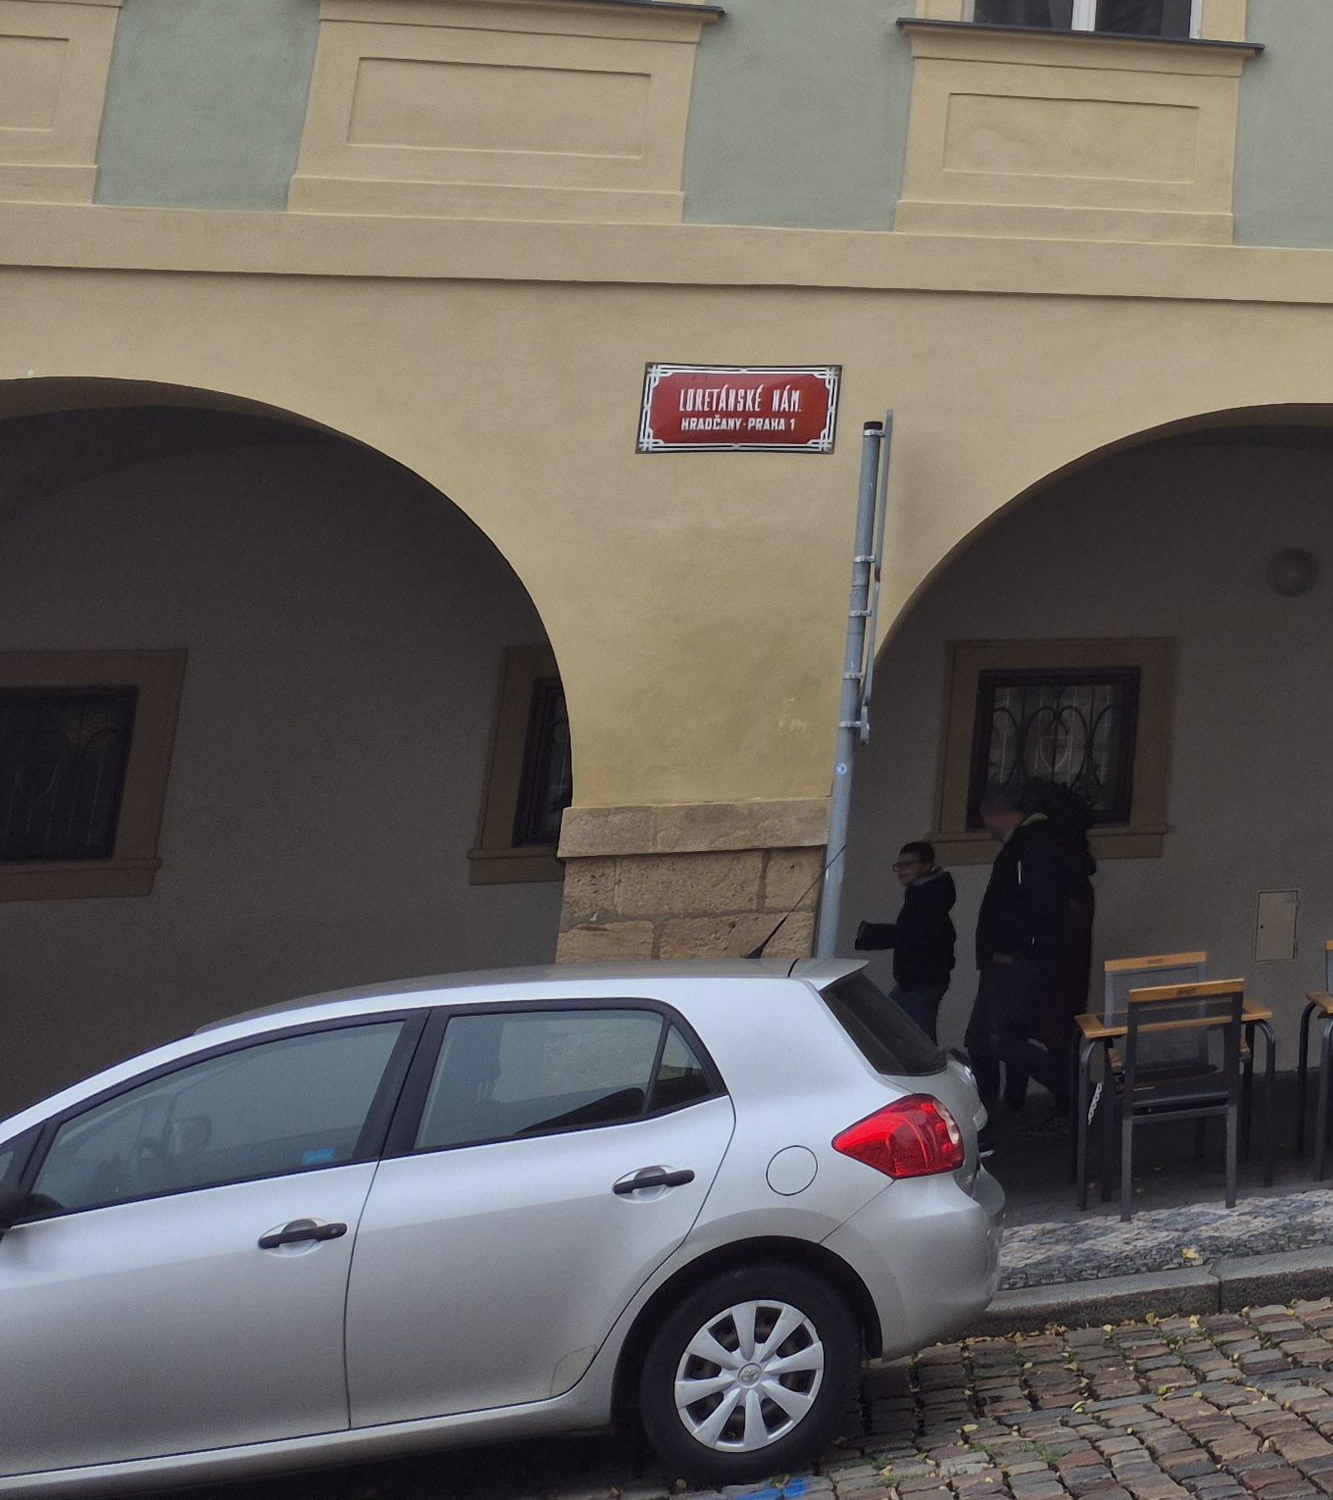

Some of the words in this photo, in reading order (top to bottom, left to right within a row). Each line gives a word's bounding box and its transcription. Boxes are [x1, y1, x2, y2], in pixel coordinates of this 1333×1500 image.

[679, 384, 765, 412] LORETÁNSKÉ
[772, 385, 802, 413] NÁM.
[681, 414, 742, 431] HRADČANY
[747, 418, 786, 431] PRAHA
[790, 418, 796, 431] 1
